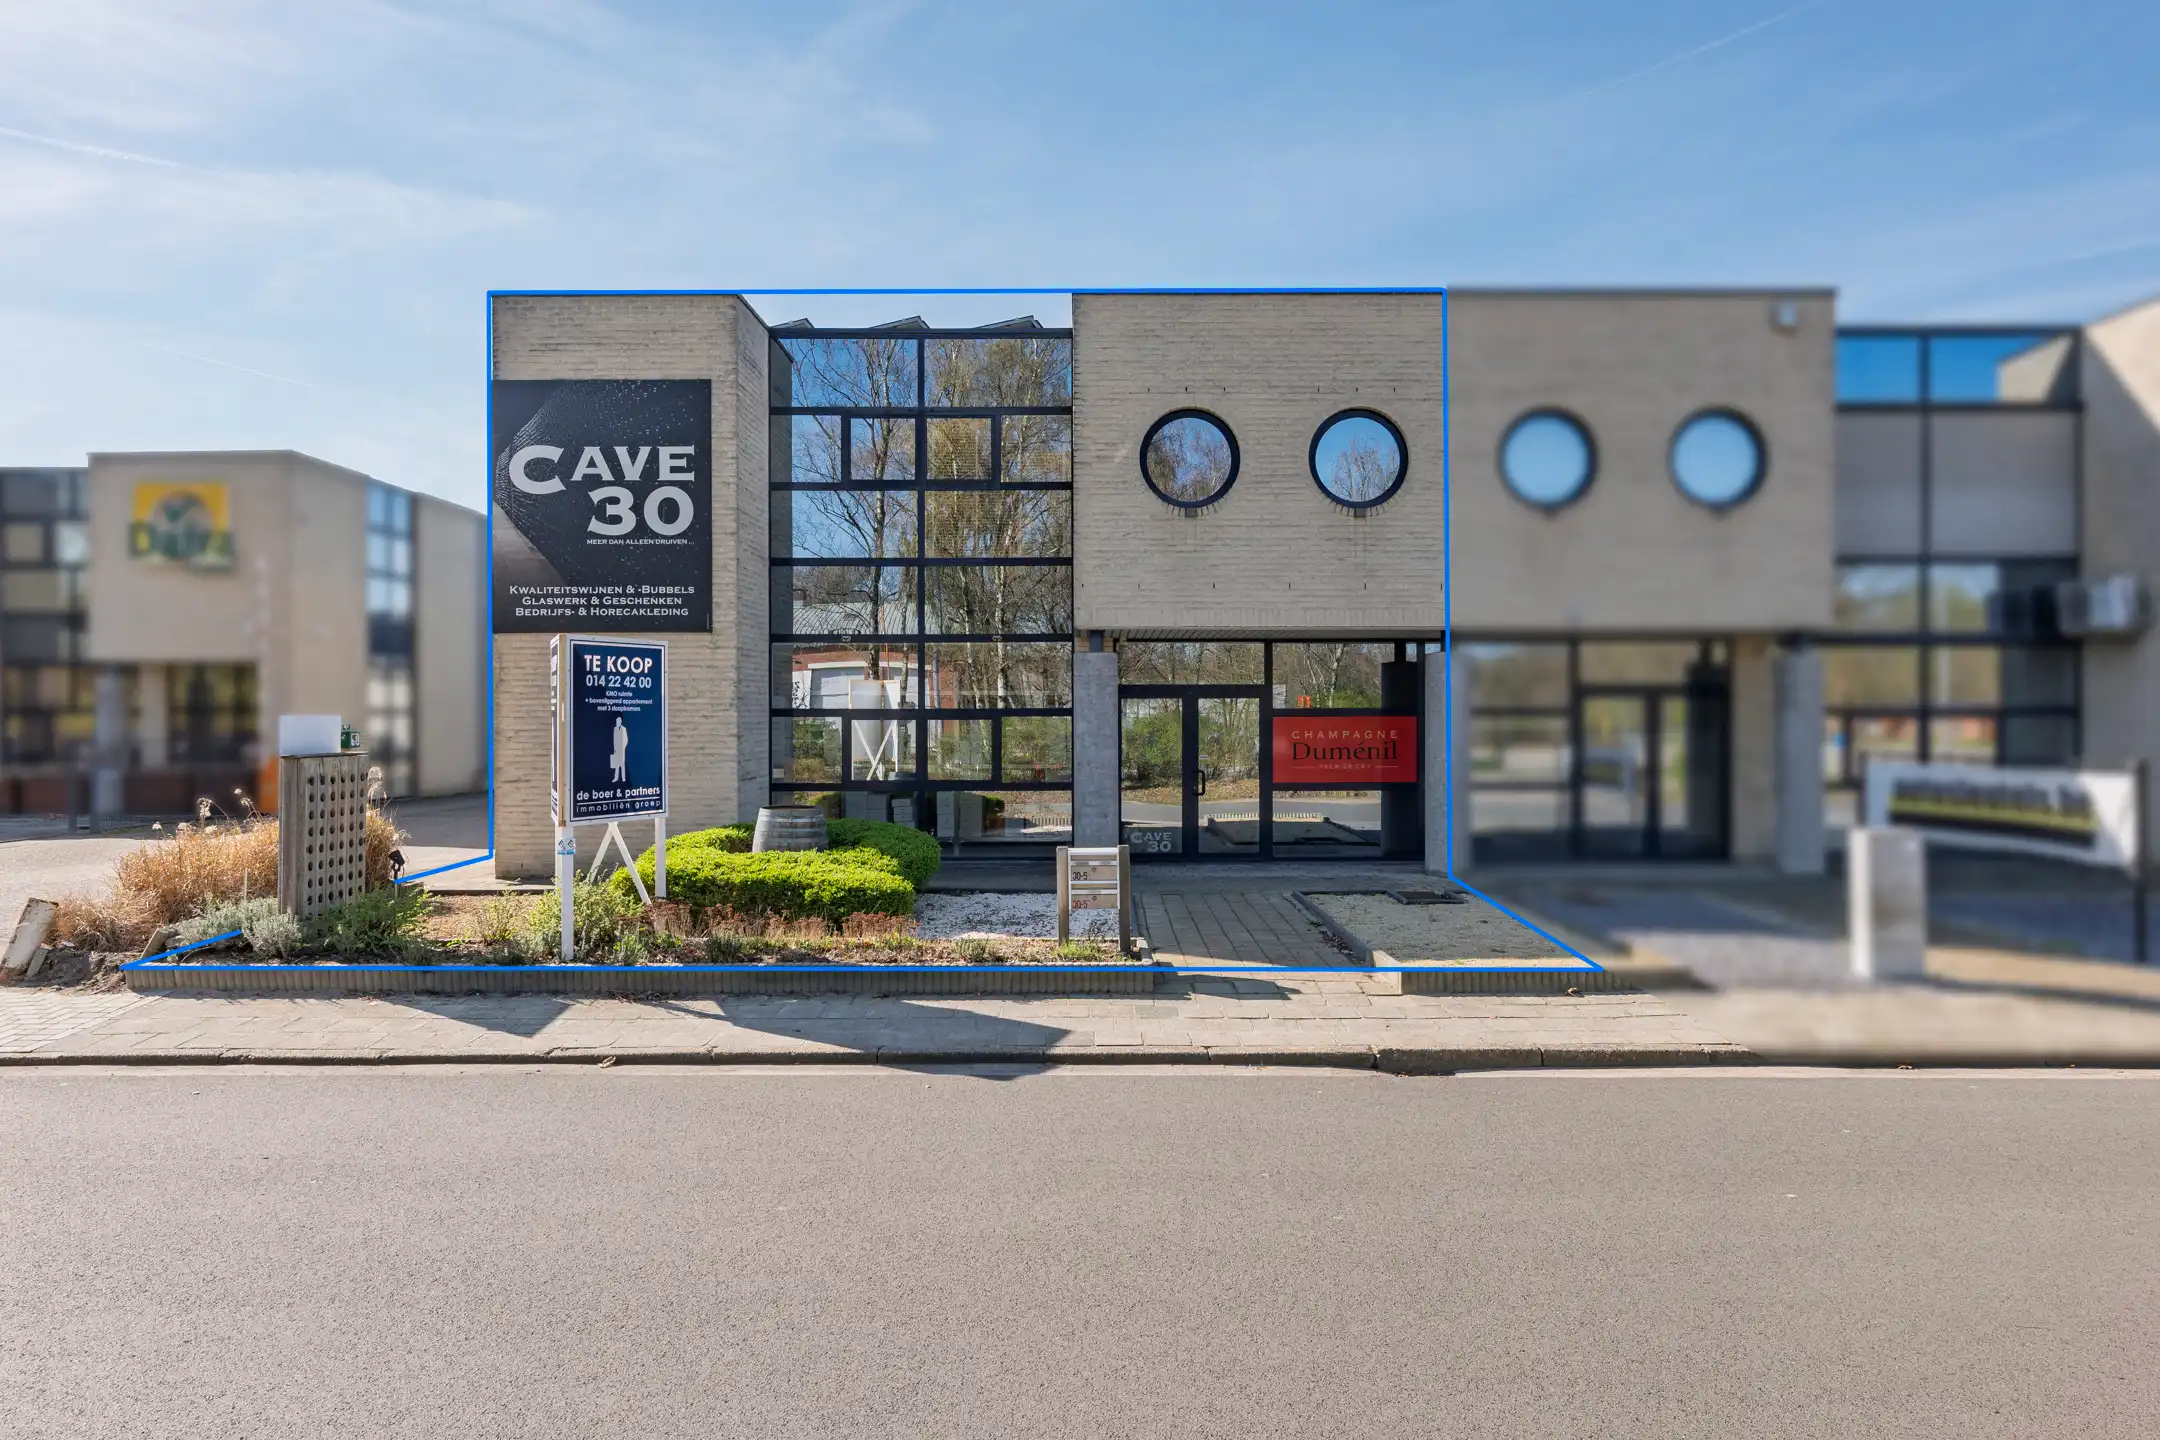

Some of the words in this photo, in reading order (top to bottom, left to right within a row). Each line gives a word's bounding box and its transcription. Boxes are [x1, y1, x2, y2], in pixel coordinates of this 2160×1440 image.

[509, 445, 695, 494] CAVE
[587, 486, 694, 535] 30
[509, 585, 622, 594] KWALITEITSWIJNEN
[626, 585, 635, 594] &
[638, 585, 695, 594] -BUBBELS
[522, 596, 588, 605] GLASWERK
[590, 596, 600, 605] &
[602, 596, 682, 605] GESCHENKEN
[515, 607, 575, 616] BEDRIJFS-
[578, 607, 587, 616] &
[590, 607, 689, 616] HORECAKLEDING
[584, 654, 601, 672] TE
[607, 655, 653, 673] KOOP
[586, 674, 606, 687] 014
[608, 675, 621, 687] 22
[623, 676, 636, 688] 42
[638, 676, 652, 688] 00
[1291, 730, 1398, 739] CHAMPAGNE
[1292, 741, 1397, 760] Duménil
[576, 791, 590, 800] de
[592, 790, 613, 799] boer
[616, 788, 622, 797] &
[625, 786, 660, 798] partners
[635, 800, 661, 809] groep
[1130, 832, 1172, 843] CAVE
[1147, 841, 1171, 852] 30
[1072, 872, 1088, 880] 30-5
[1072, 900, 1088, 909] 30-5
